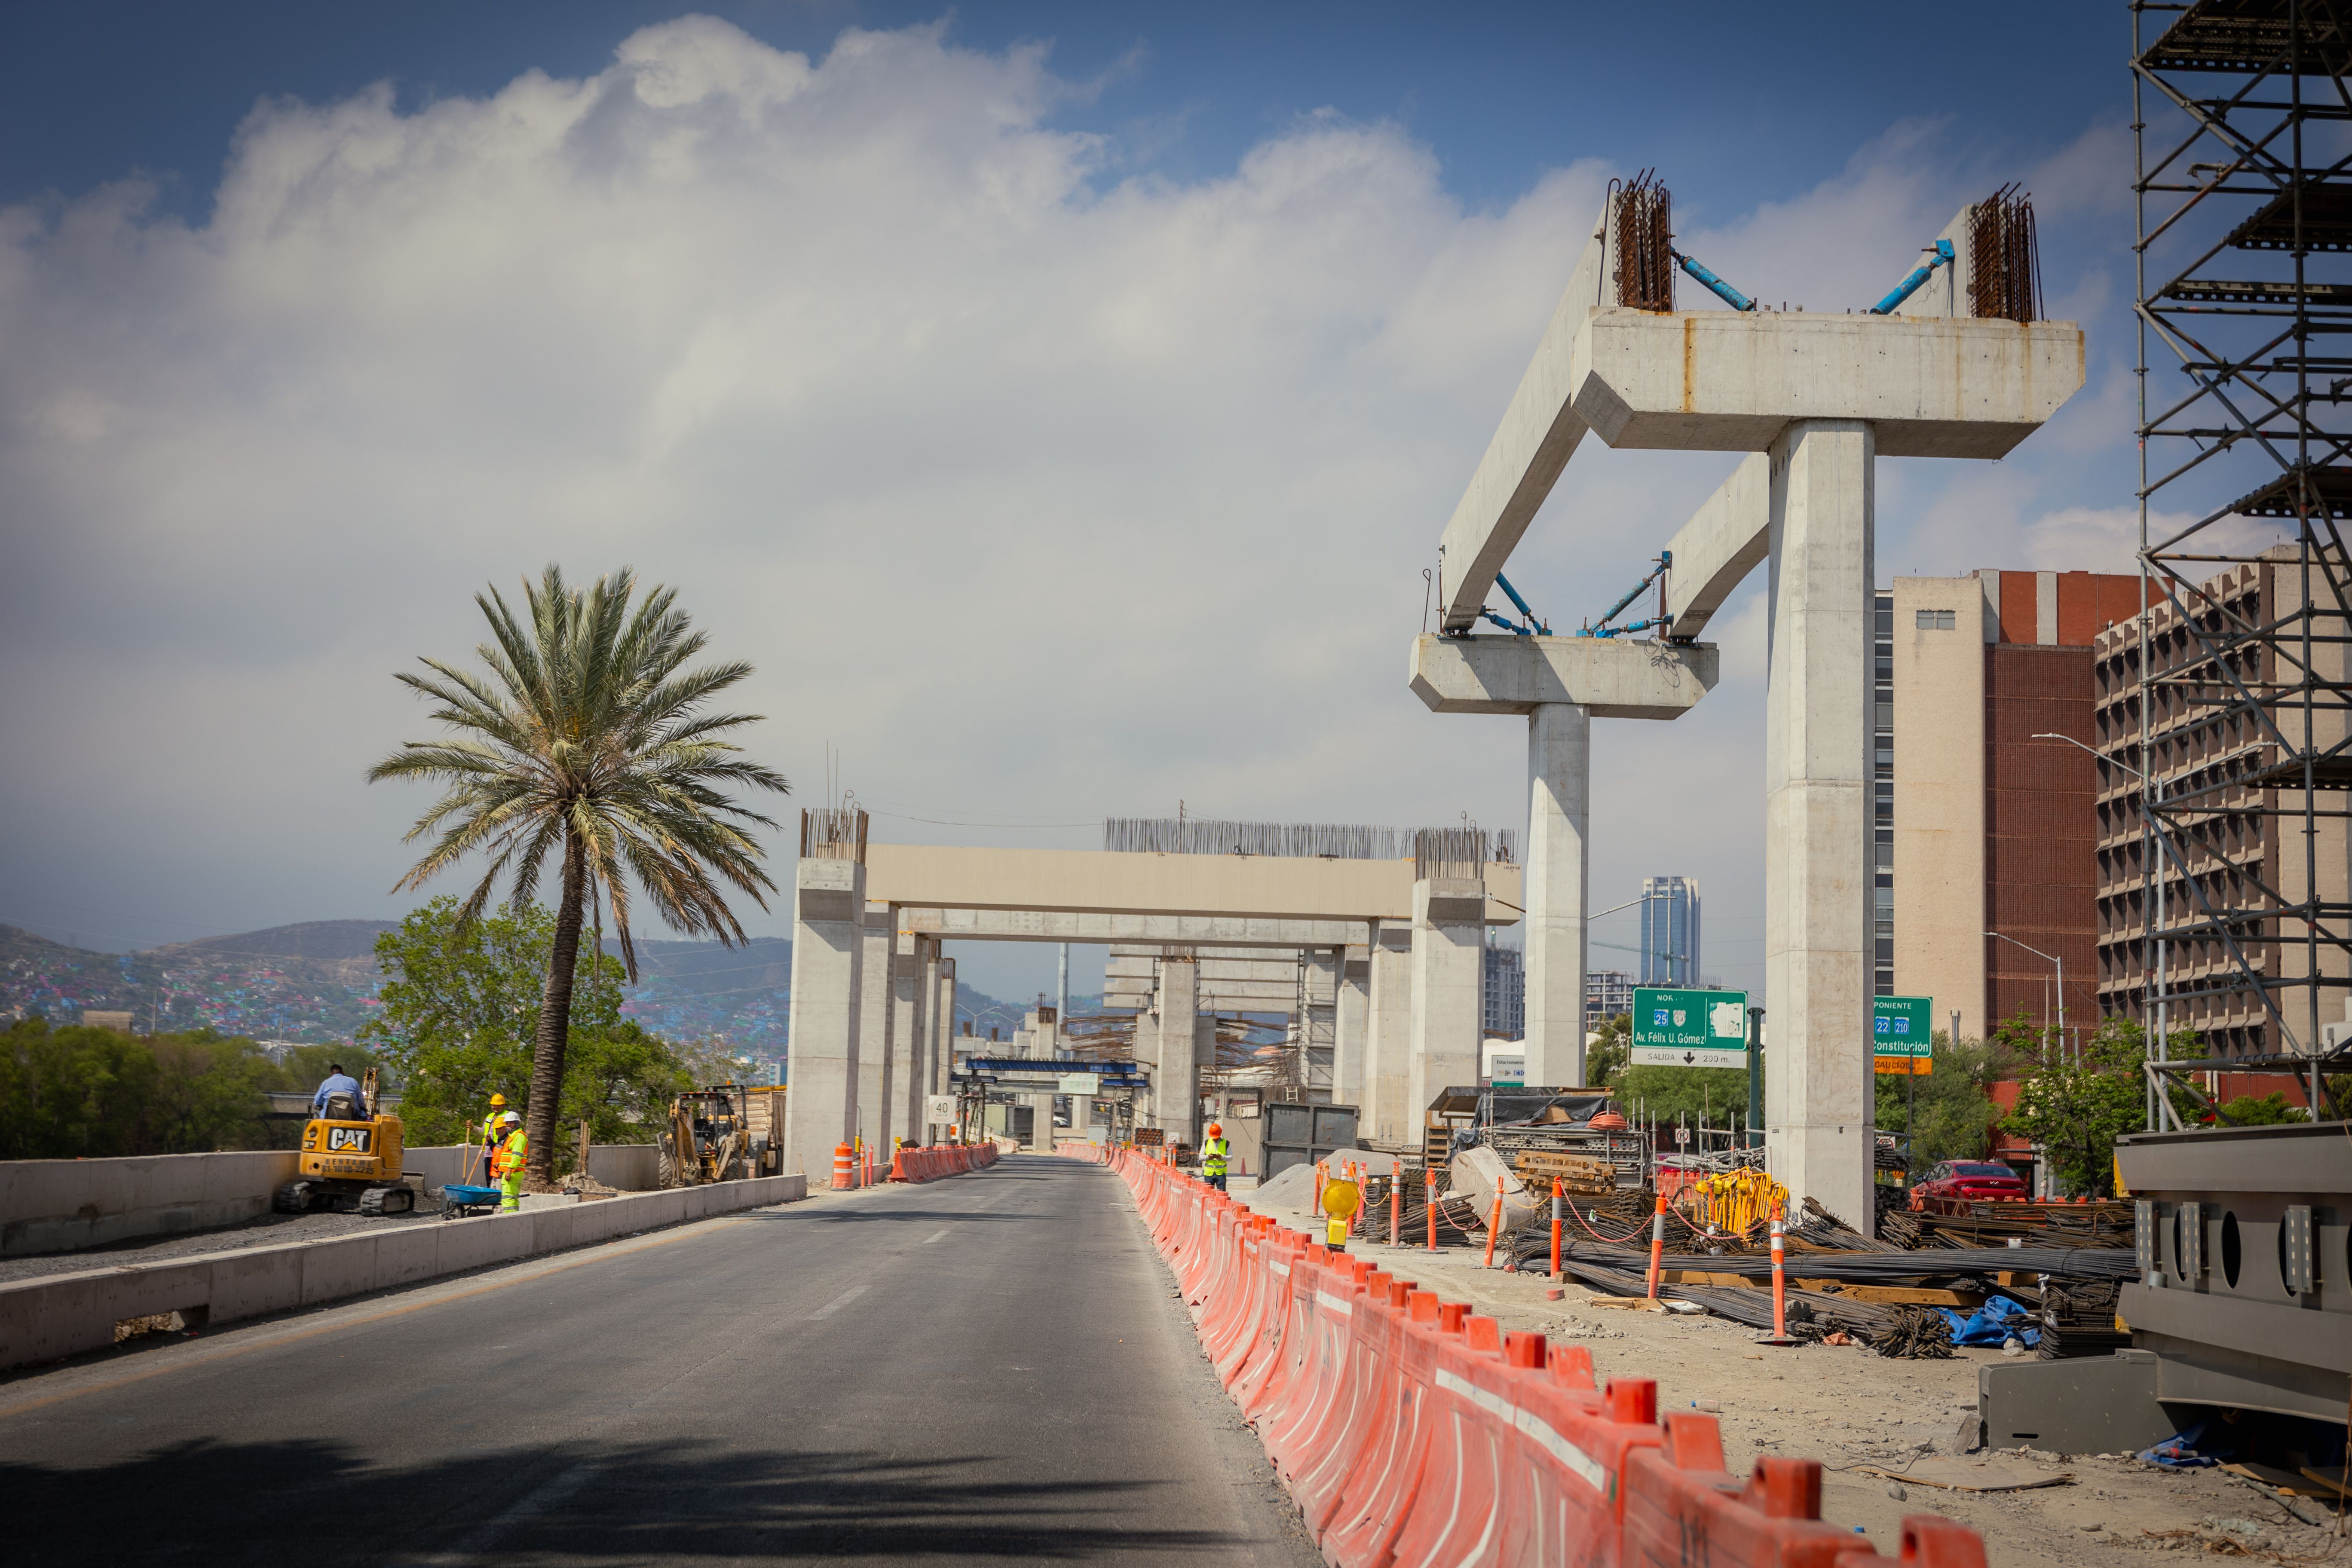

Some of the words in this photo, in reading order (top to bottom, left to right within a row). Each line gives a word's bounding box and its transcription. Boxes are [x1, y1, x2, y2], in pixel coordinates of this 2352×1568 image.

[1656, 1014, 1667, 1025] 25
[1877, 1022, 1888, 1032] 22
[1896, 1023, 1908, 1032] 210
[1635, 1032, 1645, 1042] Av.
[1648, 1032, 1666, 1043] Félix
[1669, 1033, 1675, 1043] U.
[1678, 1033, 1705, 1044] Gómez
[936, 1102, 948, 1113] 40
[330, 1129, 368, 1152] CAT
